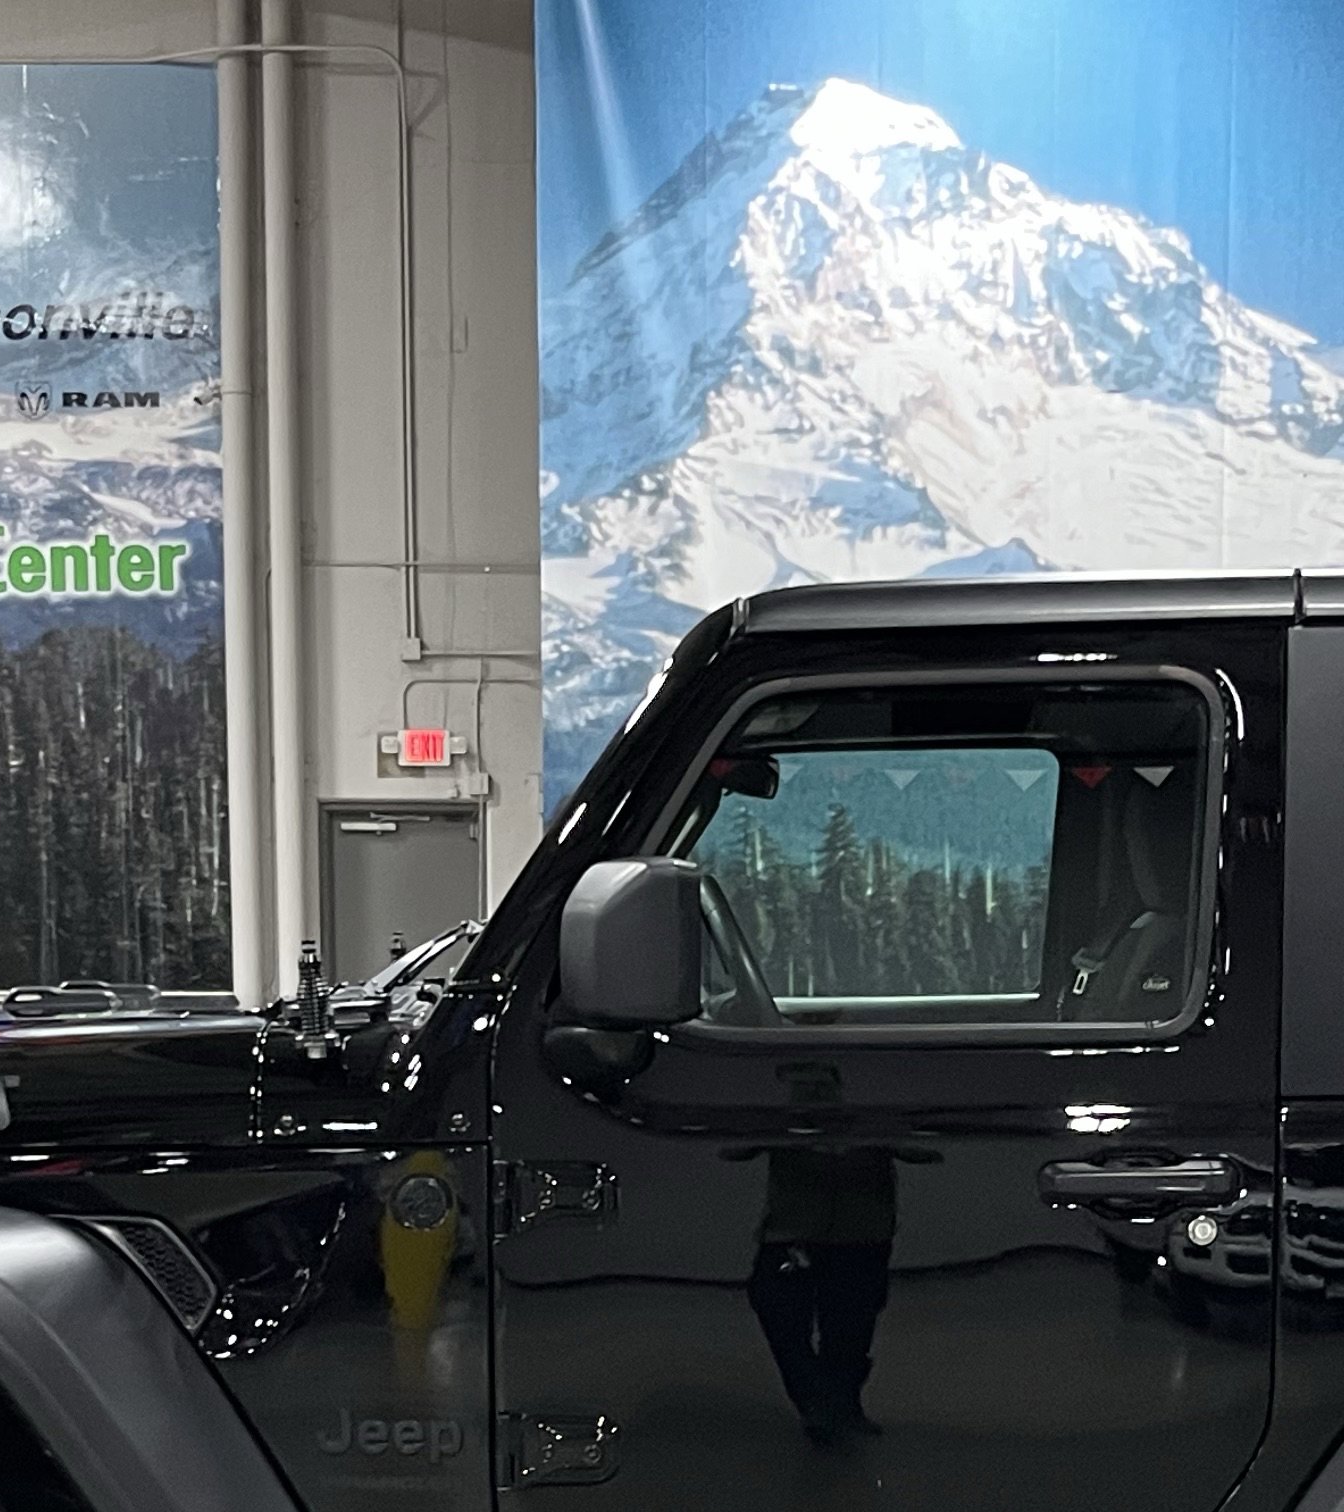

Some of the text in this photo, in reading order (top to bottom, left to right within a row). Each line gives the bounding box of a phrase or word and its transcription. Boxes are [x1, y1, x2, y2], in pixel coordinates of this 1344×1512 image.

[62, 392, 160, 407] RAM
[409, 733, 444, 760] EXIT
[316, 1407, 464, 1464] Jeep
